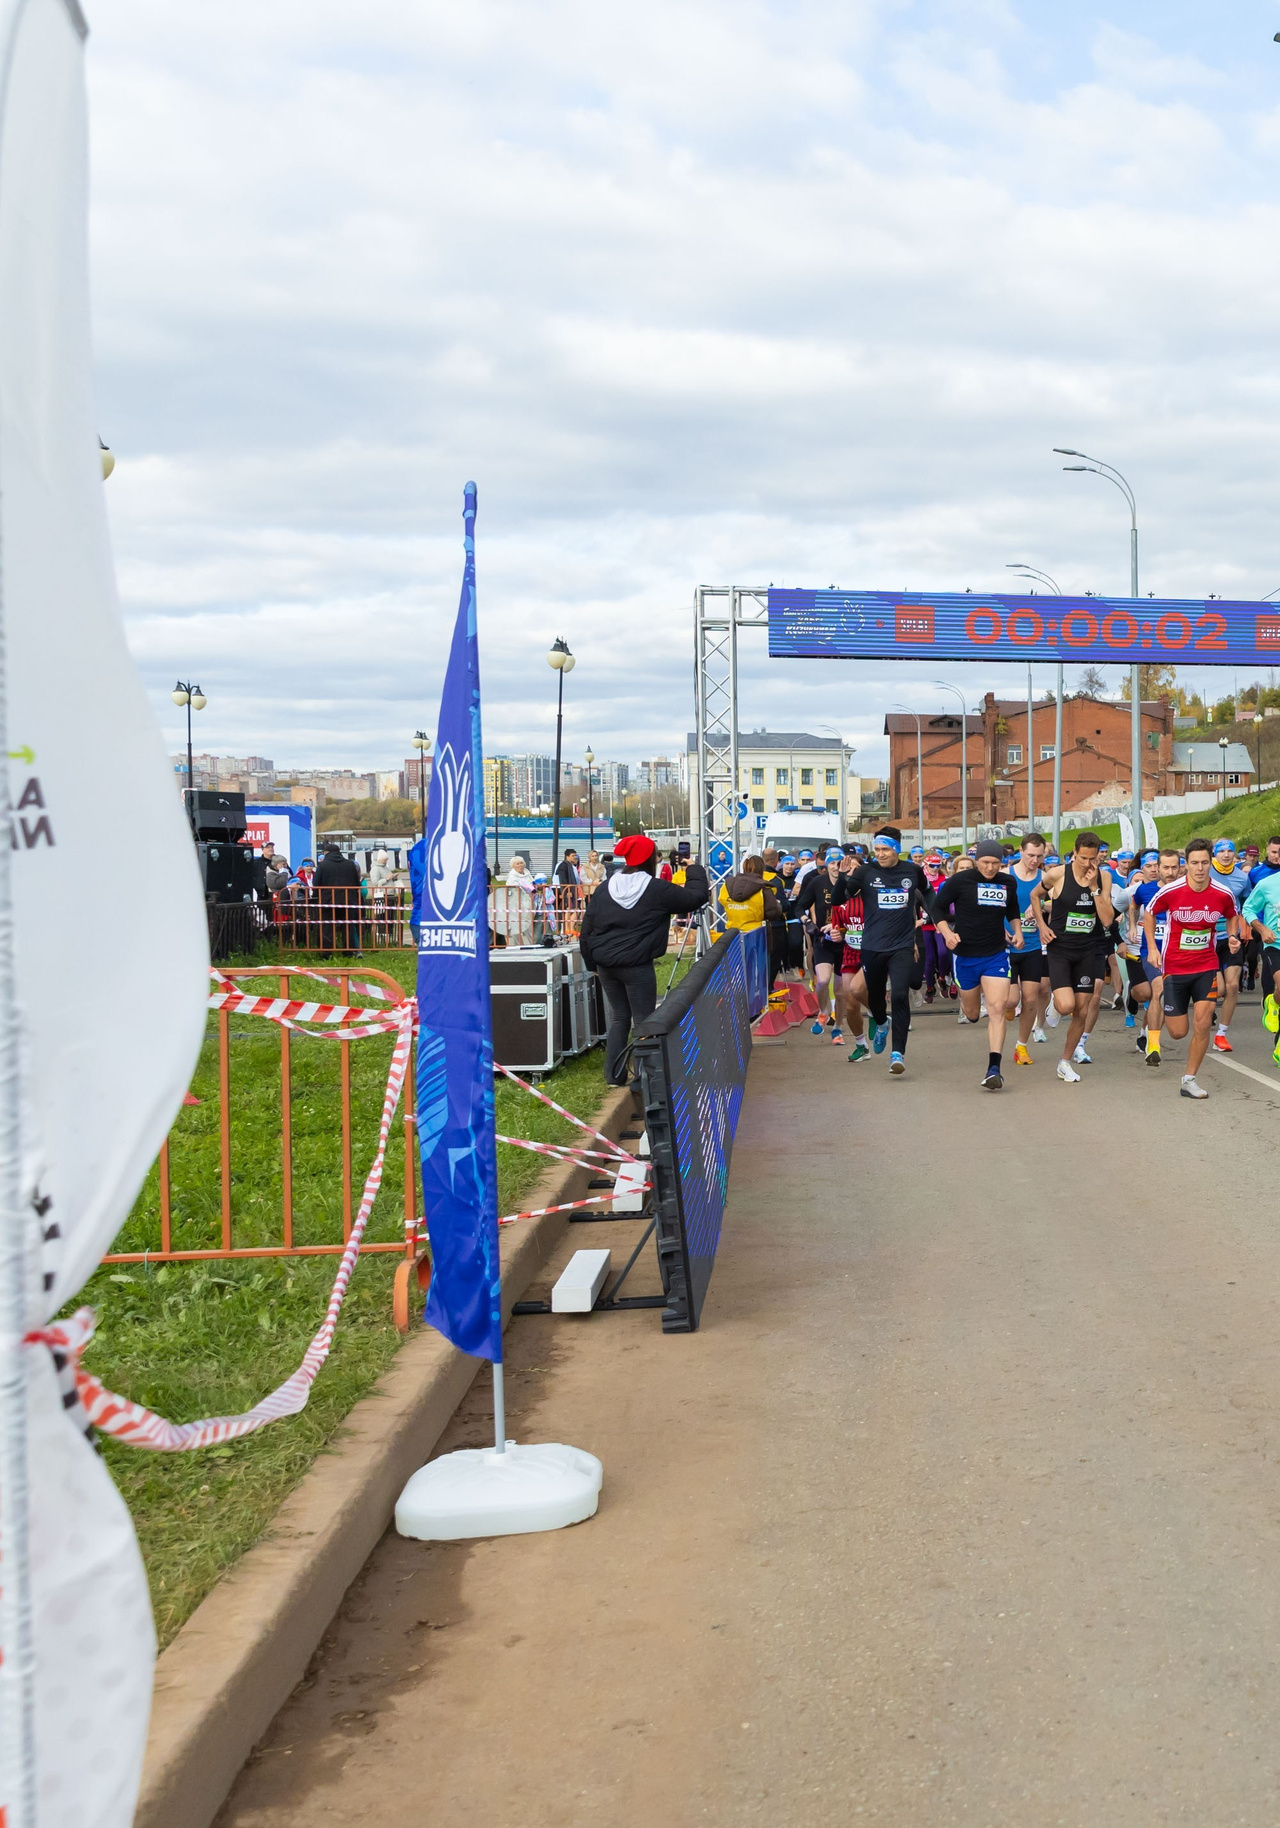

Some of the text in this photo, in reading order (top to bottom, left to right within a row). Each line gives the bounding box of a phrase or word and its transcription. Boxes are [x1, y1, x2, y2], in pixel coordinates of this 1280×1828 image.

[965, 607, 1228, 649] 00:00:02
[882, 895, 905, 903] 433
[982, 891, 1004, 900] 420
[1070, 919, 1094, 928] 500
[419, 928, 476, 950] ЗНЕЧИК
[1185, 936, 1208, 944] 504
